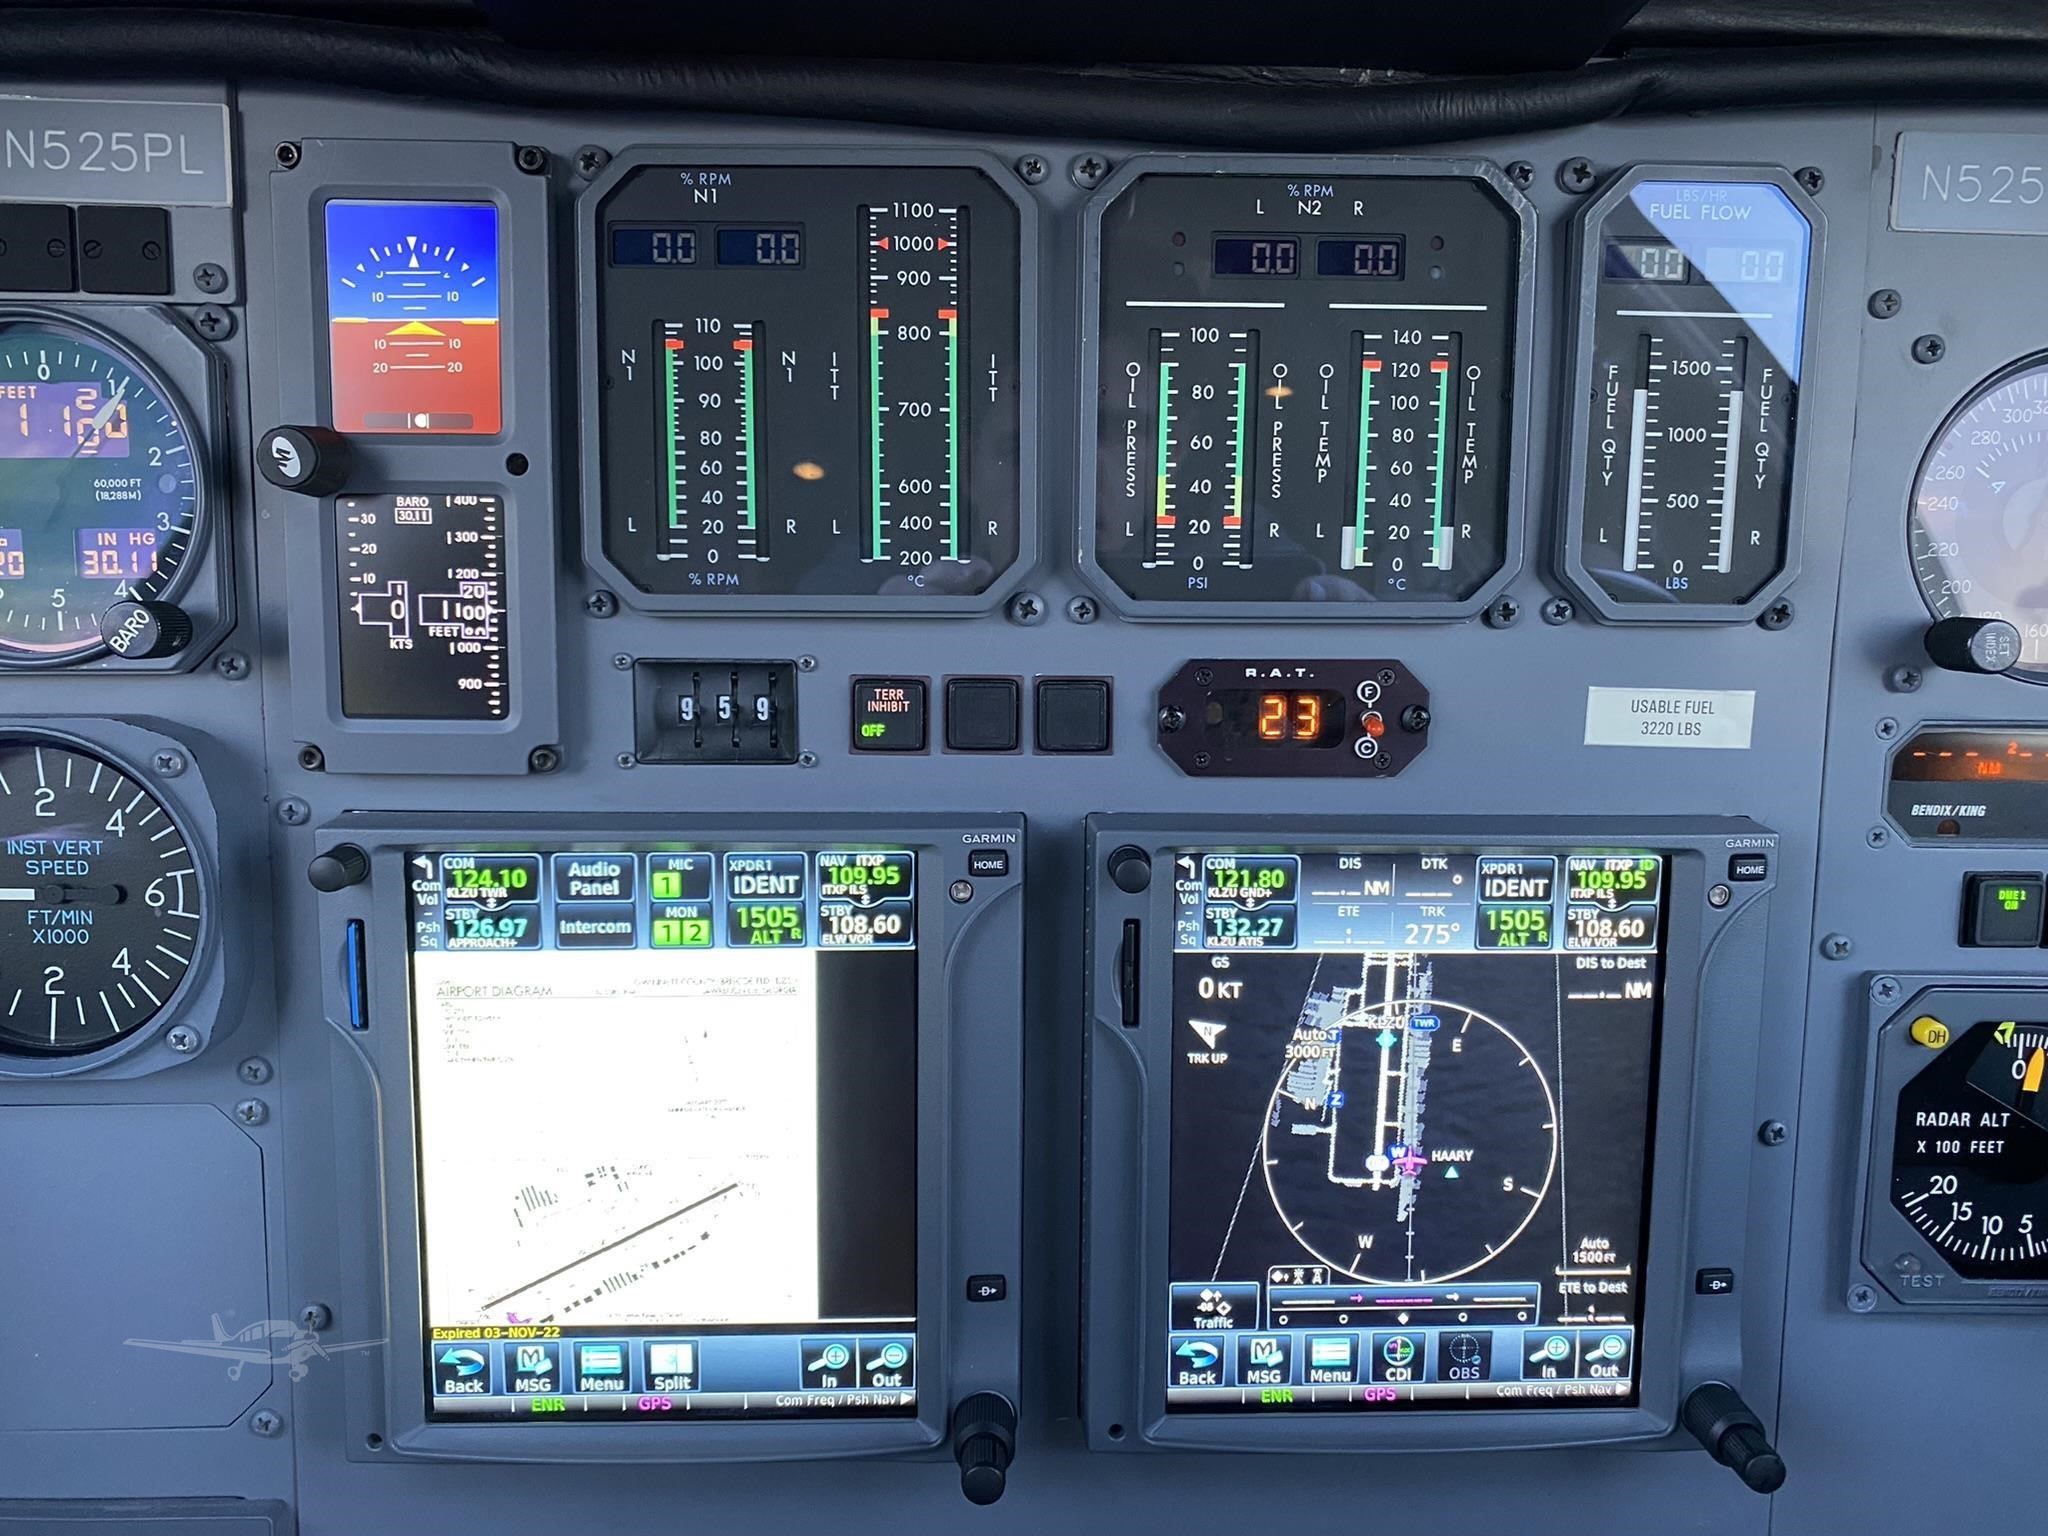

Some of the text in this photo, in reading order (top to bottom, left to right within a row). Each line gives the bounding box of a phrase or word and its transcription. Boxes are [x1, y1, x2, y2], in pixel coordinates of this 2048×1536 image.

[6, 129, 204, 174] N525PL
[680, 173, 731, 185] % RPM
[1923, 164, 2044, 204] N525
[694, 188, 717, 203] N1
[893, 203, 934, 218] 1100
[1256, 199, 1322, 215] L N2
[1650, 204, 1751, 220] FUEL FLOW
[893, 236, 934, 251] 1000
[897, 271, 930, 285] 900
[696, 318, 720, 333] 110
[898, 326, 931, 340] 800
[1190, 328, 1219, 342] 100
[1393, 330, 1422, 345] 140
[694, 356, 723, 370] 100
[1672, 360, 1711, 375] 1500
[1392, 363, 1420, 378] 120
[898, 402, 931, 417] 700
[1391, 396, 1419, 410] 100
[1668, 427, 1706, 443] 1000
[130, 479, 142, 488] FT
[898, 479, 932, 494] 600
[397, 497, 429, 507] BARO
[1666, 494, 1699, 509] 500
[899, 516, 932, 530] 400
[97, 533, 155, 545] IN HG
[1928, 542, 1958, 557] 220
[82, 551, 158, 575] 30.11
[900, 551, 932, 565] 200
[1188, 577, 1207, 589] PSI
[1666, 578, 1688, 589] LBS
[1941, 580, 1971, 594] 200
[109, 608, 150, 653] BARO
[429, 626, 459, 637] FEET
[390, 639, 412, 649] KTS
[1999, 636, 2009, 656] SET
[458, 679, 482, 689] 900
[874, 689, 904, 700] TERR
[868, 701, 910, 712] INHIBIT
[1631, 700, 1714, 714] USABLE FUEL
[1261, 699, 1316, 736] 23
[861, 724, 885, 737] OFF
[1641, 722, 1701, 736] 3220 LBS
[1911, 805, 1987, 816] BENDIX/KING
[962, 834, 1015, 843] GARMIN
[1726, 839, 1774, 848] GARMIN
[7, 840, 103, 855] INST VERT
[26, 861, 89, 875] SPEED
[444, 857, 475, 869] COM
[569, 862, 620, 877] Audio
[668, 859, 693, 870] MIC
[729, 860, 772, 871] XPDR1
[974, 861, 1003, 869] HOME
[1207, 858, 1235, 869] COM
[1339, 858, 1362, 869] DIS
[1422, 858, 1448, 869] DTK
[1481, 864, 1522, 874] XPDR1
[828, 865, 900, 884] 109.95
[1737, 866, 1764, 875] HOME
[452, 869, 528, 889] 124.10
[734, 875, 799, 894] IDENT
[1214, 869, 1284, 888] 121.80
[1578, 871, 1646, 889] 109.95
[412, 880, 441, 892] Com
[570, 880, 619, 895] Panel
[1176, 880, 1202, 891] Com
[1364, 881, 1390, 895] NM
[1485, 879, 1548, 897] IDENT
[418, 894, 439, 905] Vol
[1180, 893, 1199, 905] Vol
[445, 909, 479, 920] STBY
[666, 906, 697, 918] MON
[820, 905, 853, 916] STBY
[1206, 908, 1238, 919] STBY
[1338, 907, 1359, 916] ETE
[1420, 906, 1445, 916] TRK
[1568, 909, 1599, 920] STBY
[27, 910, 93, 925] FT/MIN
[737, 907, 798, 928] 1505
[1487, 910, 1544, 930] 1505
[417, 922, 440, 933] Psh
[454, 919, 528, 937] 126.97
[560, 920, 632, 934] Intercom
[829, 915, 900, 934] 108.60
[1178, 921, 1199, 931] Psh
[1214, 918, 1284, 937] 132.27
[1576, 920, 1644, 937] 108.60
[33, 929, 89, 944] X1000
[421, 936, 438, 948] Sq
[751, 928, 801, 944] ALT R
[1181, 935, 1196, 946] Sq
[1207, 937, 1264, 946] KLZU ATIS
[1211, 956, 1230, 969] GS
[1576, 957, 1647, 969] DIS to Dest
[436, 986, 553, 997] AIRPORT DIAGRAM
[1625, 982, 1652, 999] NM
[1293, 1028, 1325, 1041] Auto
[1928, 1029, 1946, 1043] DH
[1187, 1053, 1228, 1064] TRK UP
[1916, 1112, 2010, 1127] RADAR ALT
[1917, 1141, 2004, 1153] X 100 FEET
[1432, 1150, 1473, 1162] HAARY
[1580, 1237, 1609, 1249] Auto
[1559, 1282, 1628, 1293] ETE to Dest
[1900, 1275, 1945, 1287] TEST
[1194, 1317, 1233, 1329] Traffic
[433, 1328, 481, 1340] Expired
[1248, 1371, 1281, 1383] MSG
[1311, 1370, 1351, 1382] Menu
[1386, 1368, 1411, 1381] CDI
[1449, 1367, 1480, 1380] OBS
[1542, 1365, 1556, 1378] In
[1590, 1365, 1619, 1377] Out
[581, 1378, 624, 1391] Menu
[654, 1377, 691, 1392] Split
[823, 1375, 836, 1388] In
[872, 1374, 902, 1387] Out
[1180, 1372, 1216, 1384] Back
[445, 1380, 483, 1392] Back
[515, 1379, 551, 1392] MSG
[1261, 1389, 1293, 1403] ENR
[1365, 1388, 1396, 1401] GPS
[532, 1398, 565, 1411] ENR
[639, 1397, 671, 1410] GPS
